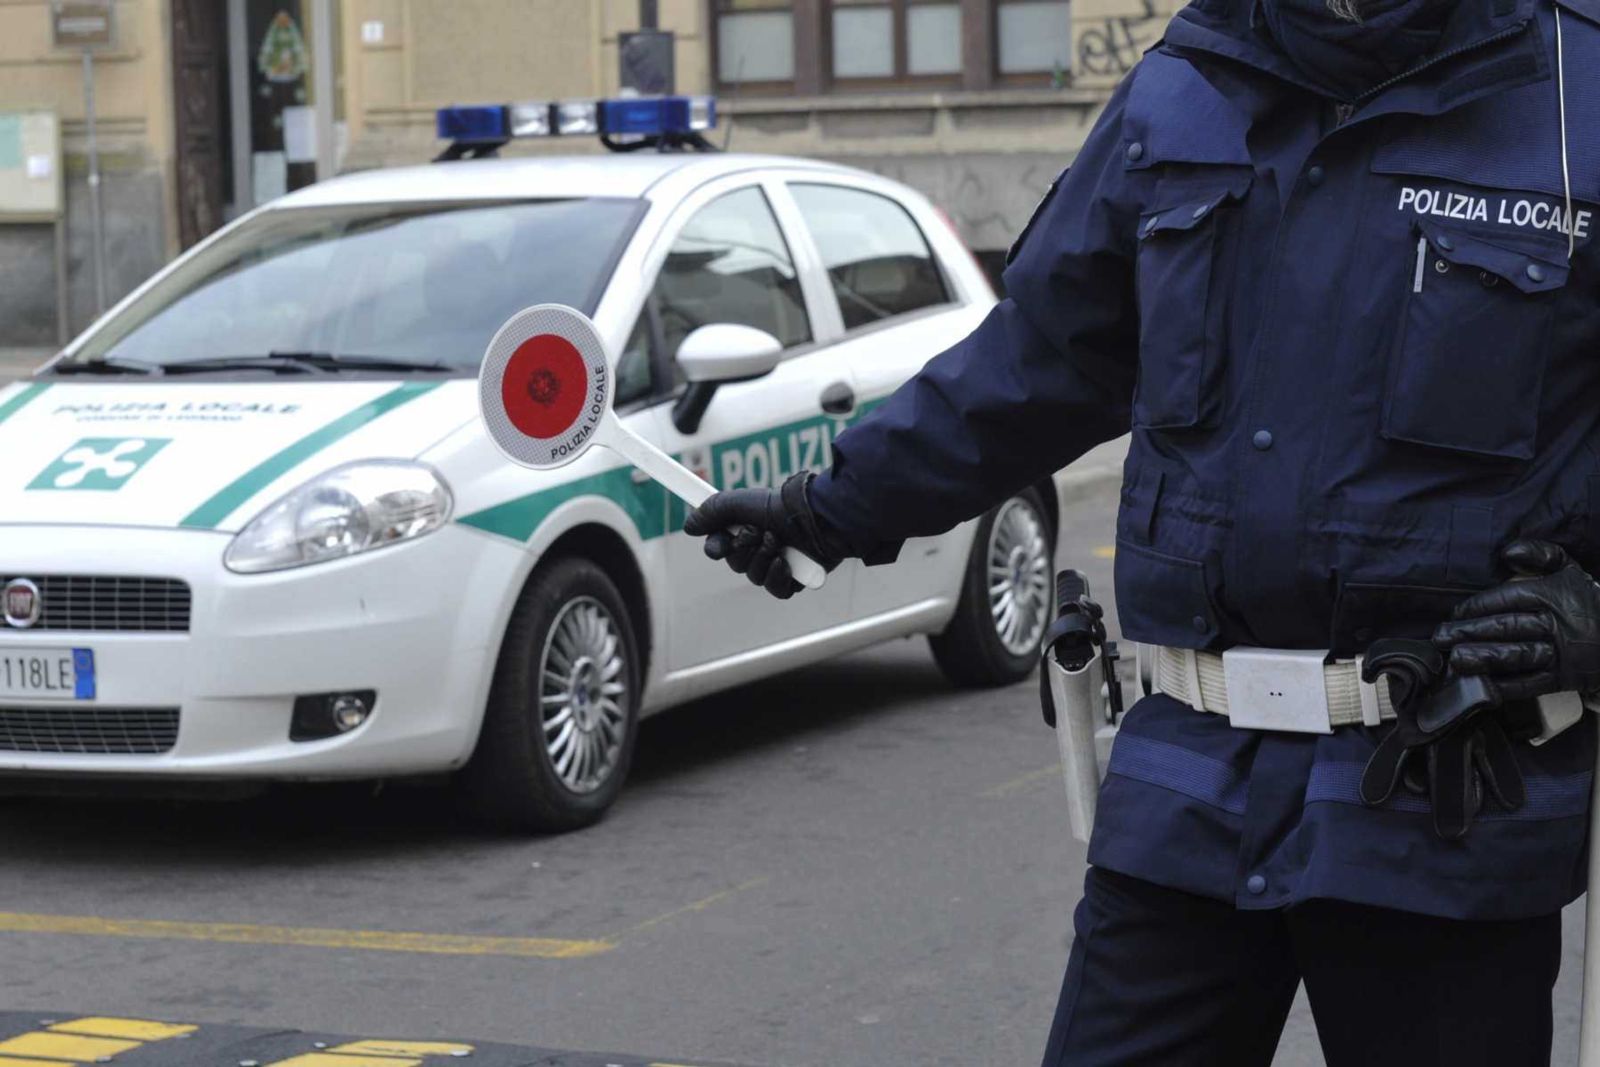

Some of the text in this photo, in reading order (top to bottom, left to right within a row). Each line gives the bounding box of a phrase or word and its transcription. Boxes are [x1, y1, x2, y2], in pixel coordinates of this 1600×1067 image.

[1398, 187, 1592, 238] POLIZIA LOCALE
[181, 402, 301, 414] LOCALE
[550, 365, 605, 459] POLIZIA LOCALE
[721, 420, 847, 492] POLIZI
[4, 658, 72, 690] 118LE
